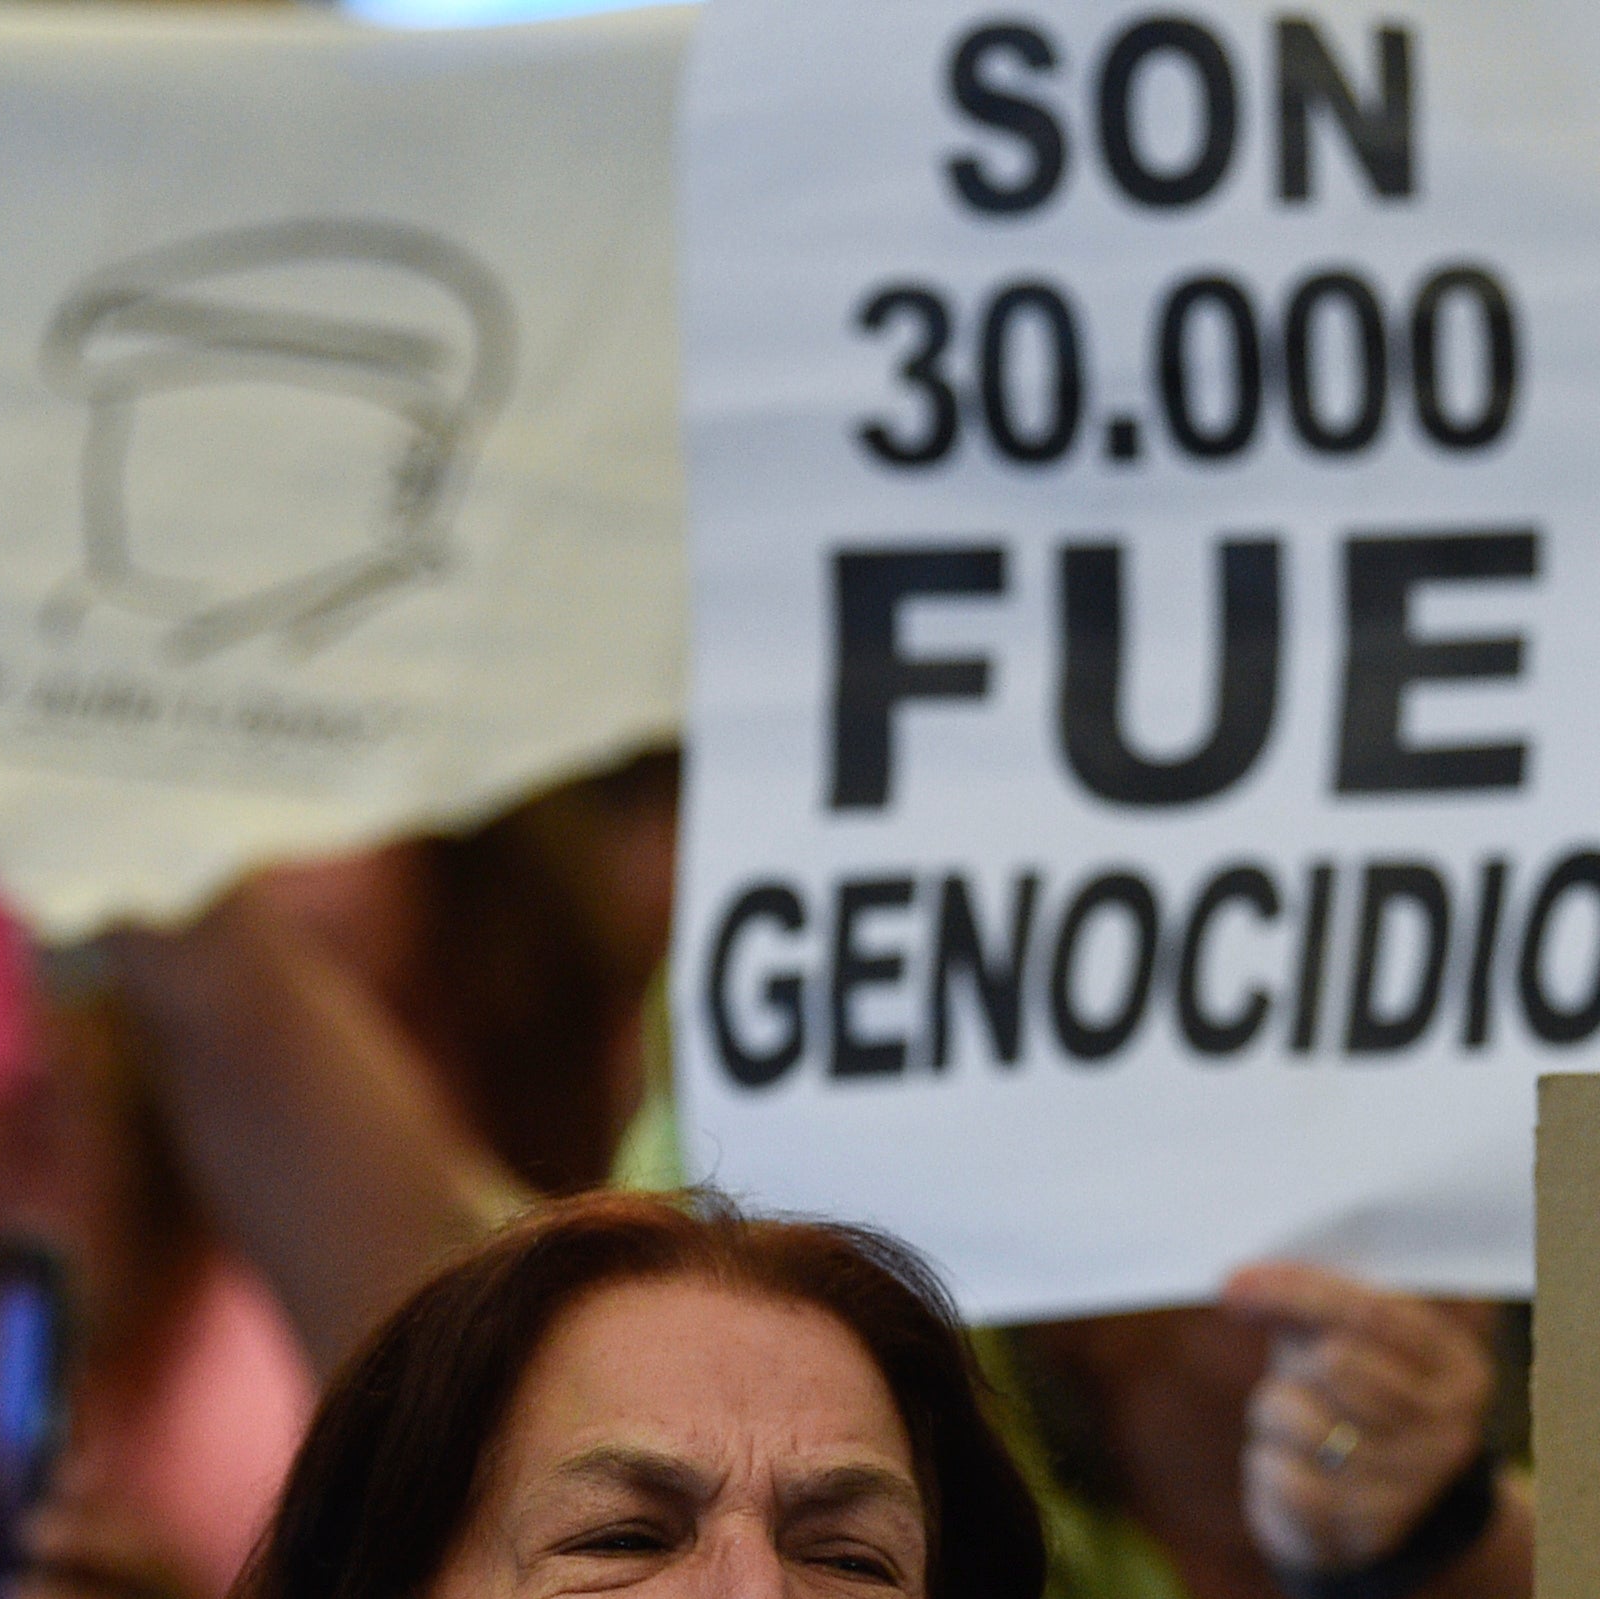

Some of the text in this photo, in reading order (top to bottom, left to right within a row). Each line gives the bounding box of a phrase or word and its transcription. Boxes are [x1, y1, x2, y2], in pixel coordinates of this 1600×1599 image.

[944, 13, 1419, 220] SON
[852, 257, 1523, 472] 30.000
[824, 523, 1544, 814] FUE
